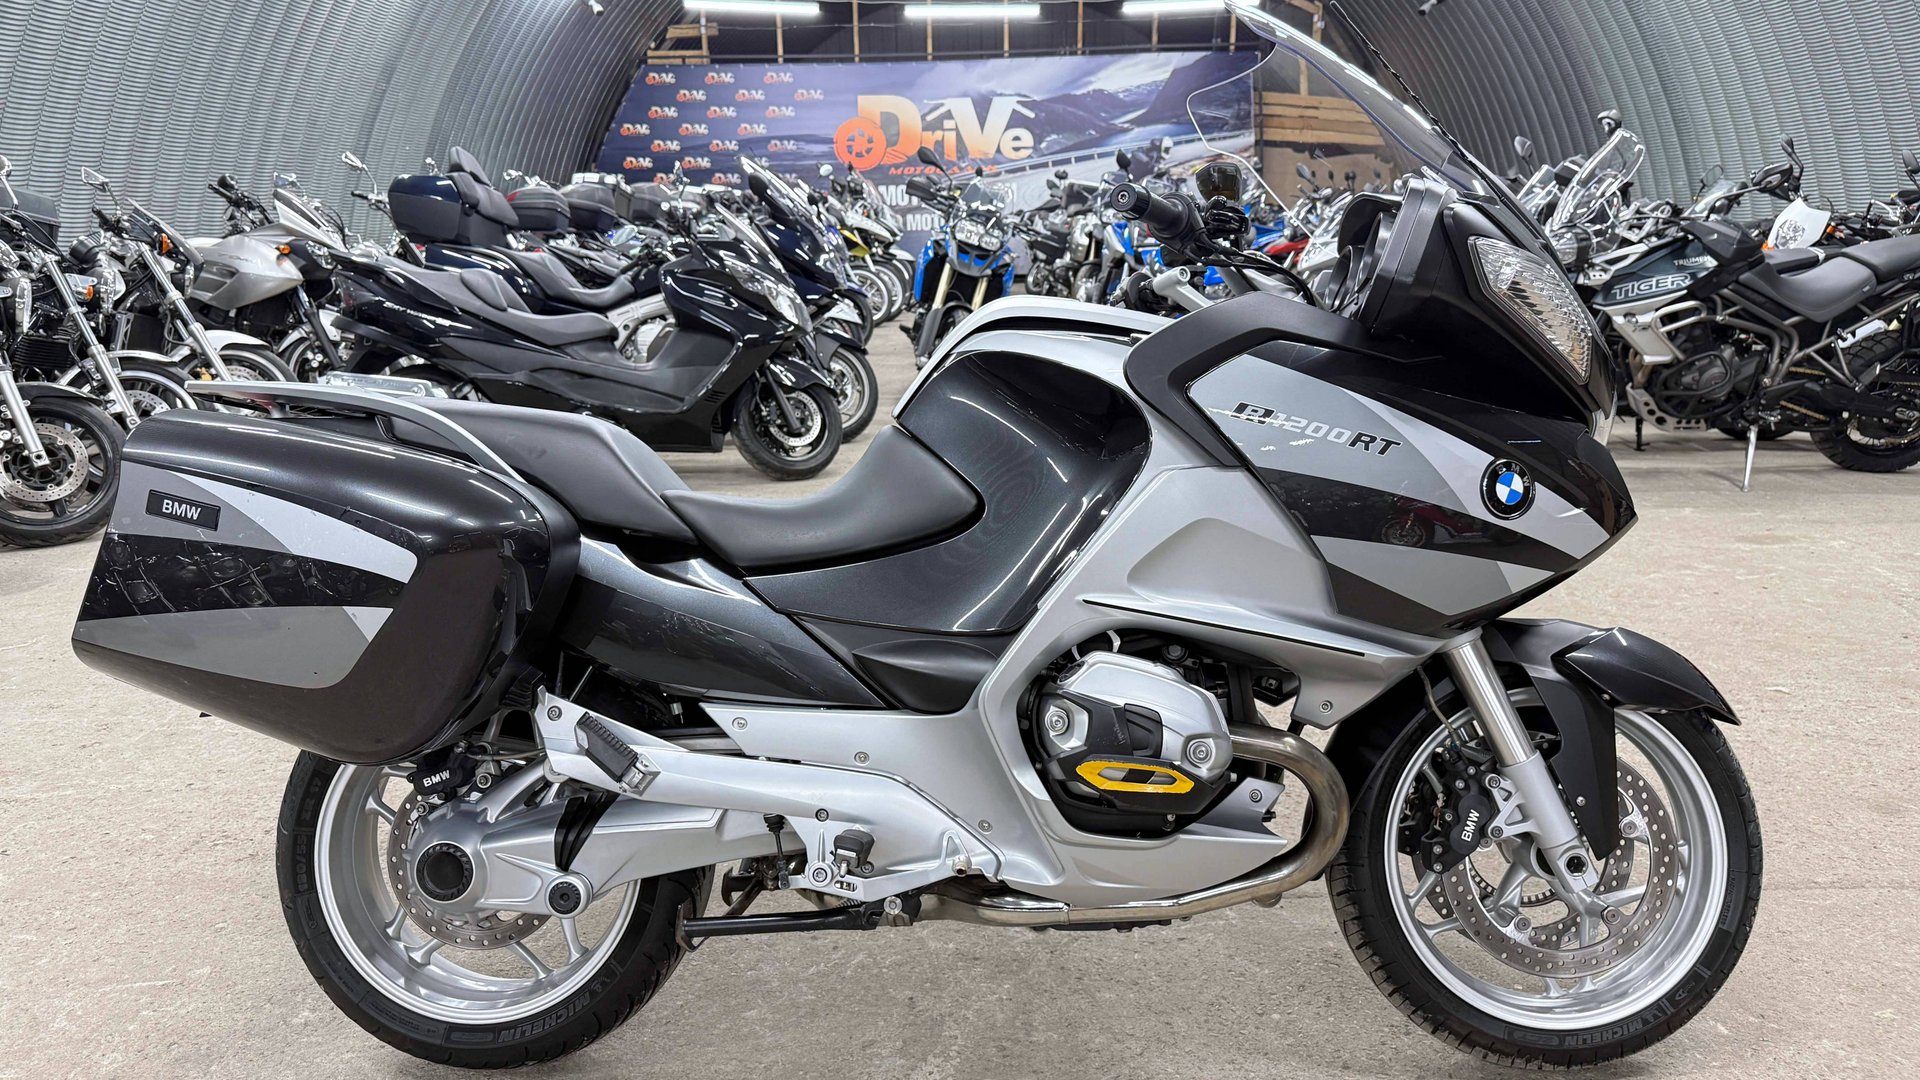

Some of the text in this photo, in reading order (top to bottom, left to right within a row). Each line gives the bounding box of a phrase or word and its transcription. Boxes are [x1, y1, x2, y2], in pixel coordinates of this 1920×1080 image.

[857, 95, 1035, 160] DriVe
[1673, 254, 1711, 267] TRIUMPH
[1611, 272, 1692, 300] TIGER
[1495, 462, 1530, 487] BMW
[162, 499, 202, 521] BMW
[423, 769, 451, 787] BMW
[1461, 809, 1480, 842] BMW
[498, 991, 590, 1043] MICHELIN
[1564, 1017, 1643, 1047] MICHELIN
